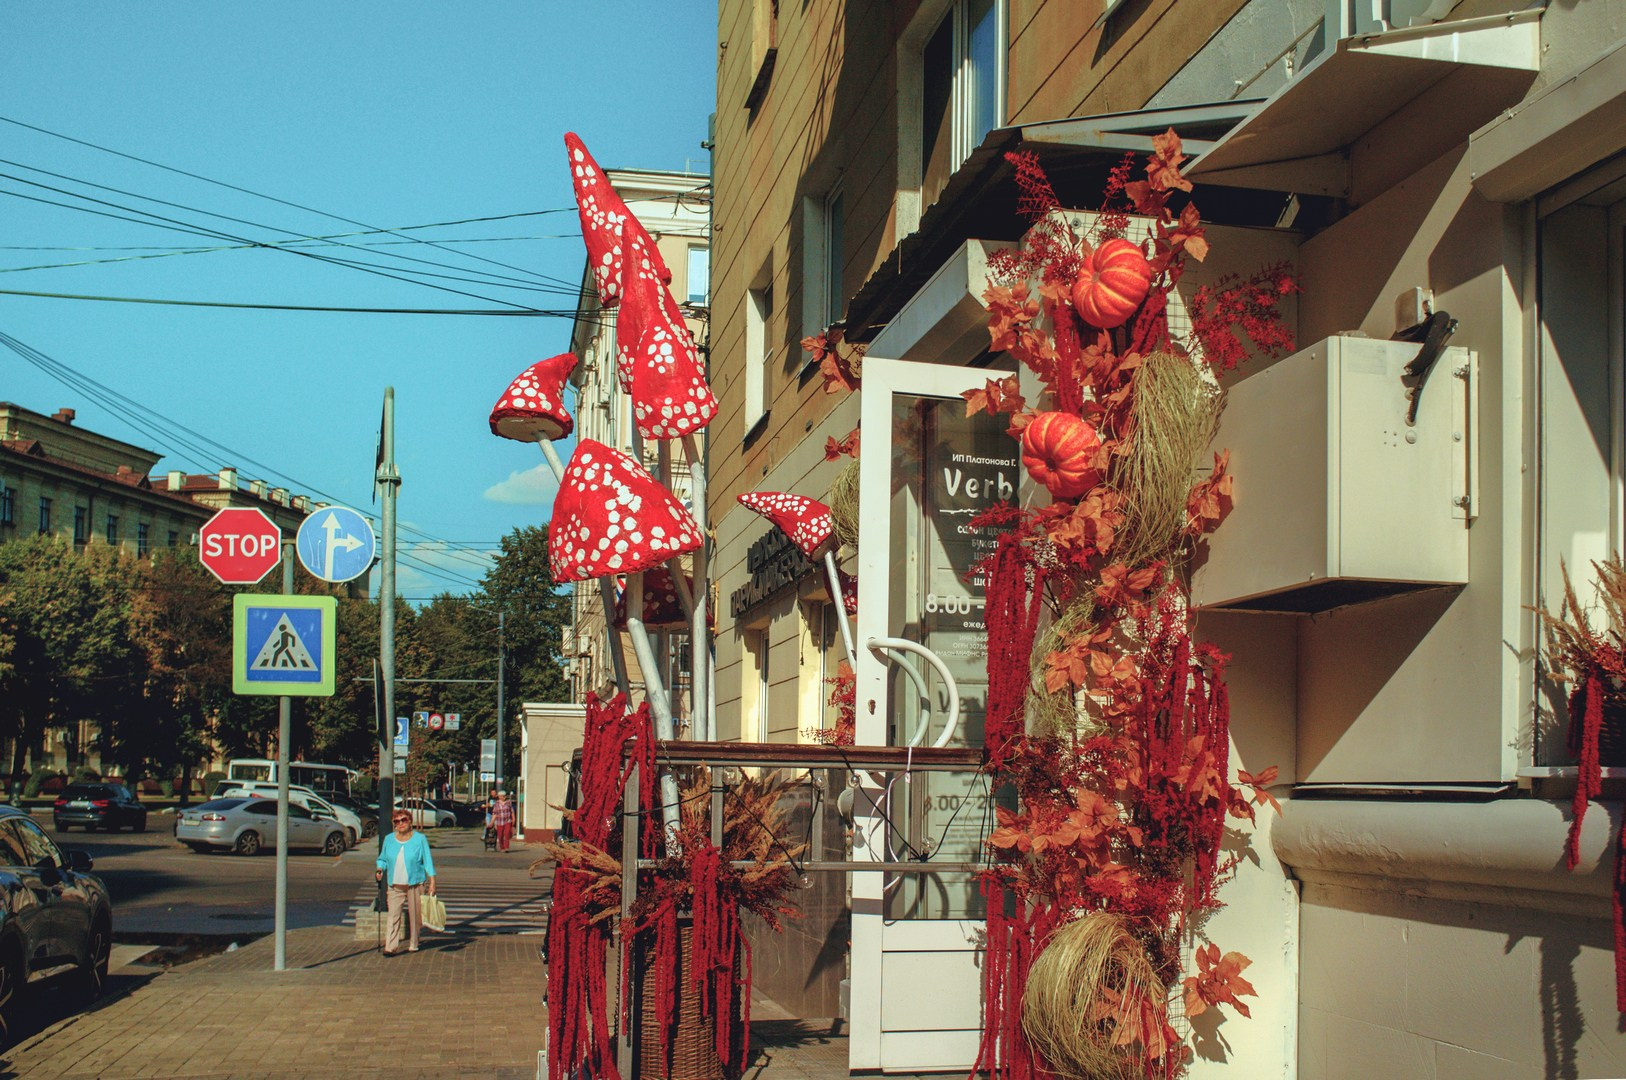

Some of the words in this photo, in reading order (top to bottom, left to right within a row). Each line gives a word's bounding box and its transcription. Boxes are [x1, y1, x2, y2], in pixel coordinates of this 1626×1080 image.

[952, 454, 965, 462] ИП
[966, 454, 1010, 466] Платонова
[1011, 459, 1017, 467] Г.
[205, 533, 276, 557] STOP
[926, 593, 971, 615] 8.00
